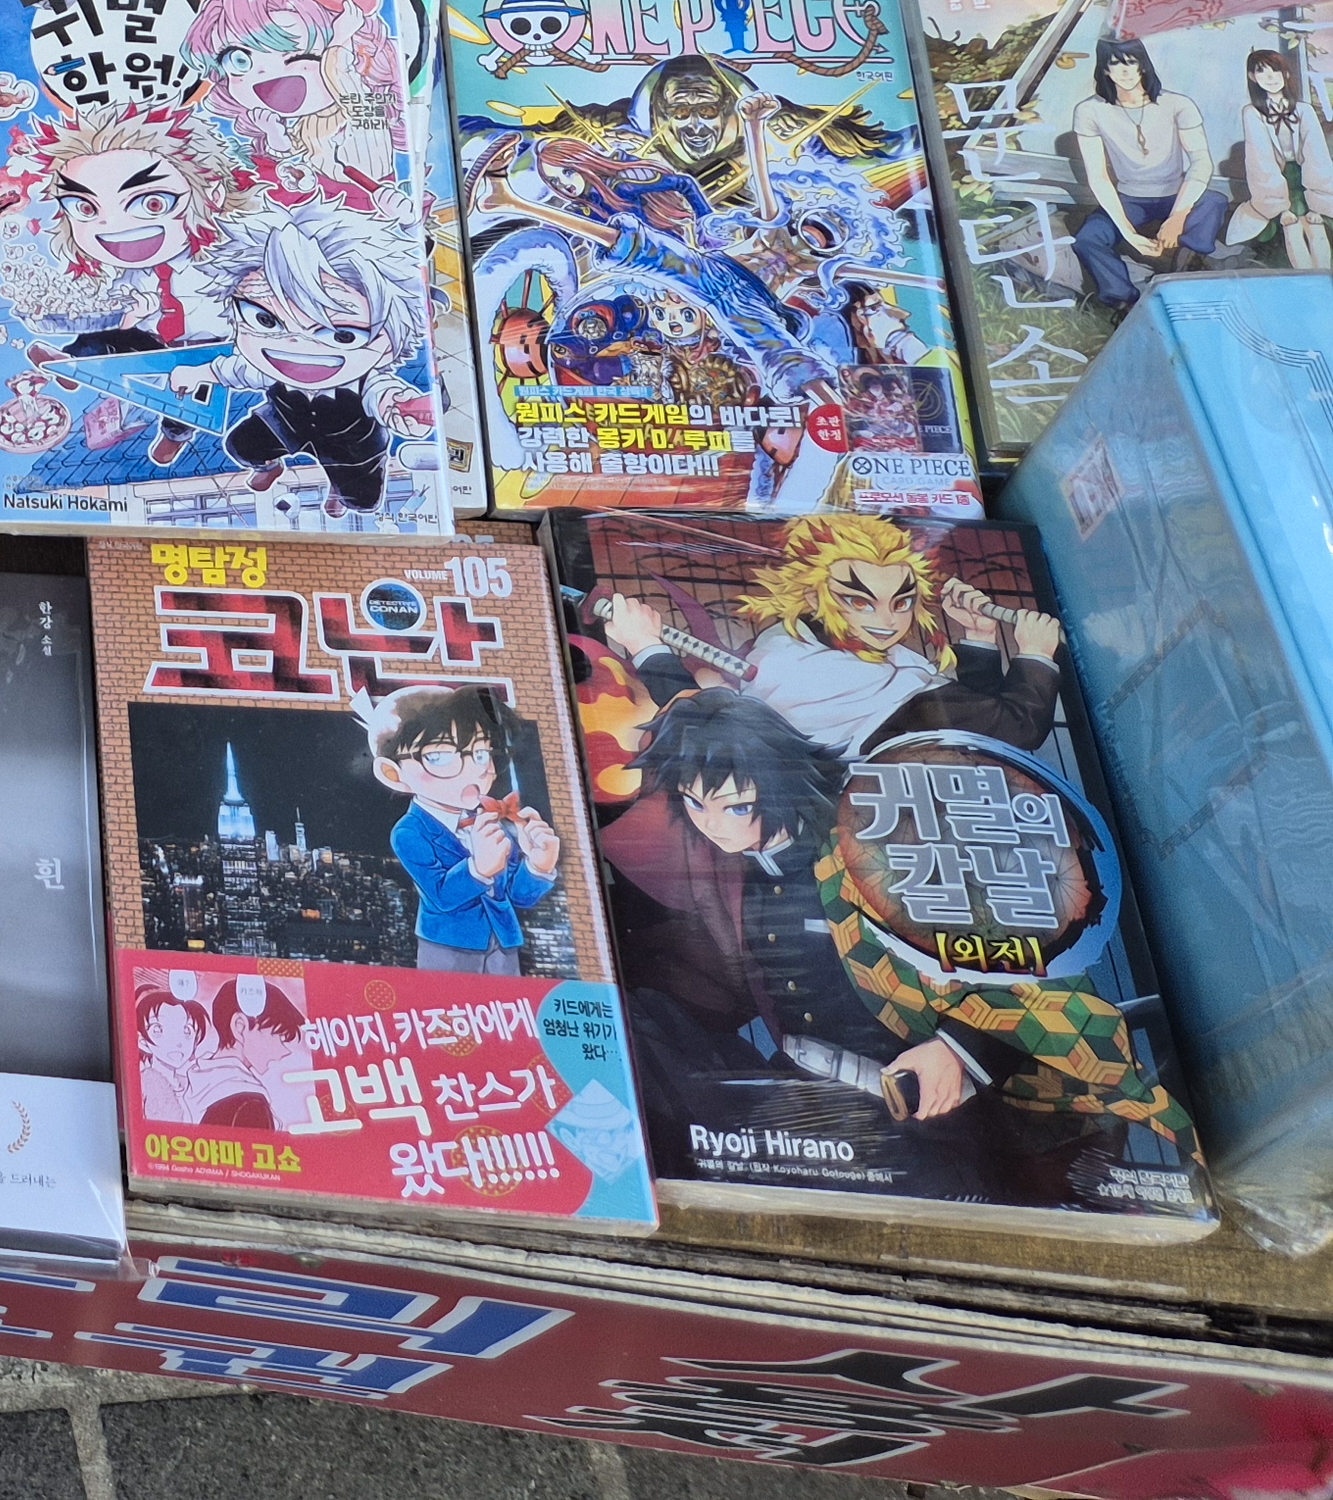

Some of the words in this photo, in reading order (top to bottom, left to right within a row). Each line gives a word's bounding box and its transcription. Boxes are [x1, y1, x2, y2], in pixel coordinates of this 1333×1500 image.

[45, 51, 189, 105] 학원!
[855, 70, 894, 82] 한국어판
[516, 403, 590, 426] 원피스
[594, 403, 717, 427] 카드게임의
[721, 405, 802, 428] 바다로!
[517, 427, 591, 450] 강력한
[596, 428, 642, 451] 몽키
[683, 429, 756, 453] 루피를
[520, 450, 594, 474] 사용해
[600, 451, 719, 477] 출항이다!!!
[3, 492, 63, 510] Natsuki
[67, 495, 128, 513] Hokami
[152, 542, 267, 586] 명탐정
[404, 568, 448, 581] VOLUME
[445, 558, 512, 597] 105
[369, 604, 419, 615] CONAN
[41, 634, 53, 656] 소설
[144, 585, 514, 706] 코난
[848, 762, 1071, 848] 귀멸의
[35, 857, 64, 890] 흰
[888, 844, 1058, 929] 칼날
[554, 998, 614, 1019] 키드에게는
[301, 1014, 397, 1061] 헤이지,
[394, 997, 537, 1052] 카즈하에게
[542, 1019, 581, 1040] 엄청난
[583, 1021, 618, 1042] 위기가
[284, 1056, 432, 1135] 고백
[437, 1069, 555, 1122] 찬스가
[145, 1133, 243, 1168] 아오야마
[254, 1141, 302, 1174] 고쇼
[691, 1124, 758, 1156] Ryoji
[764, 1129, 854, 1161] Hirano
